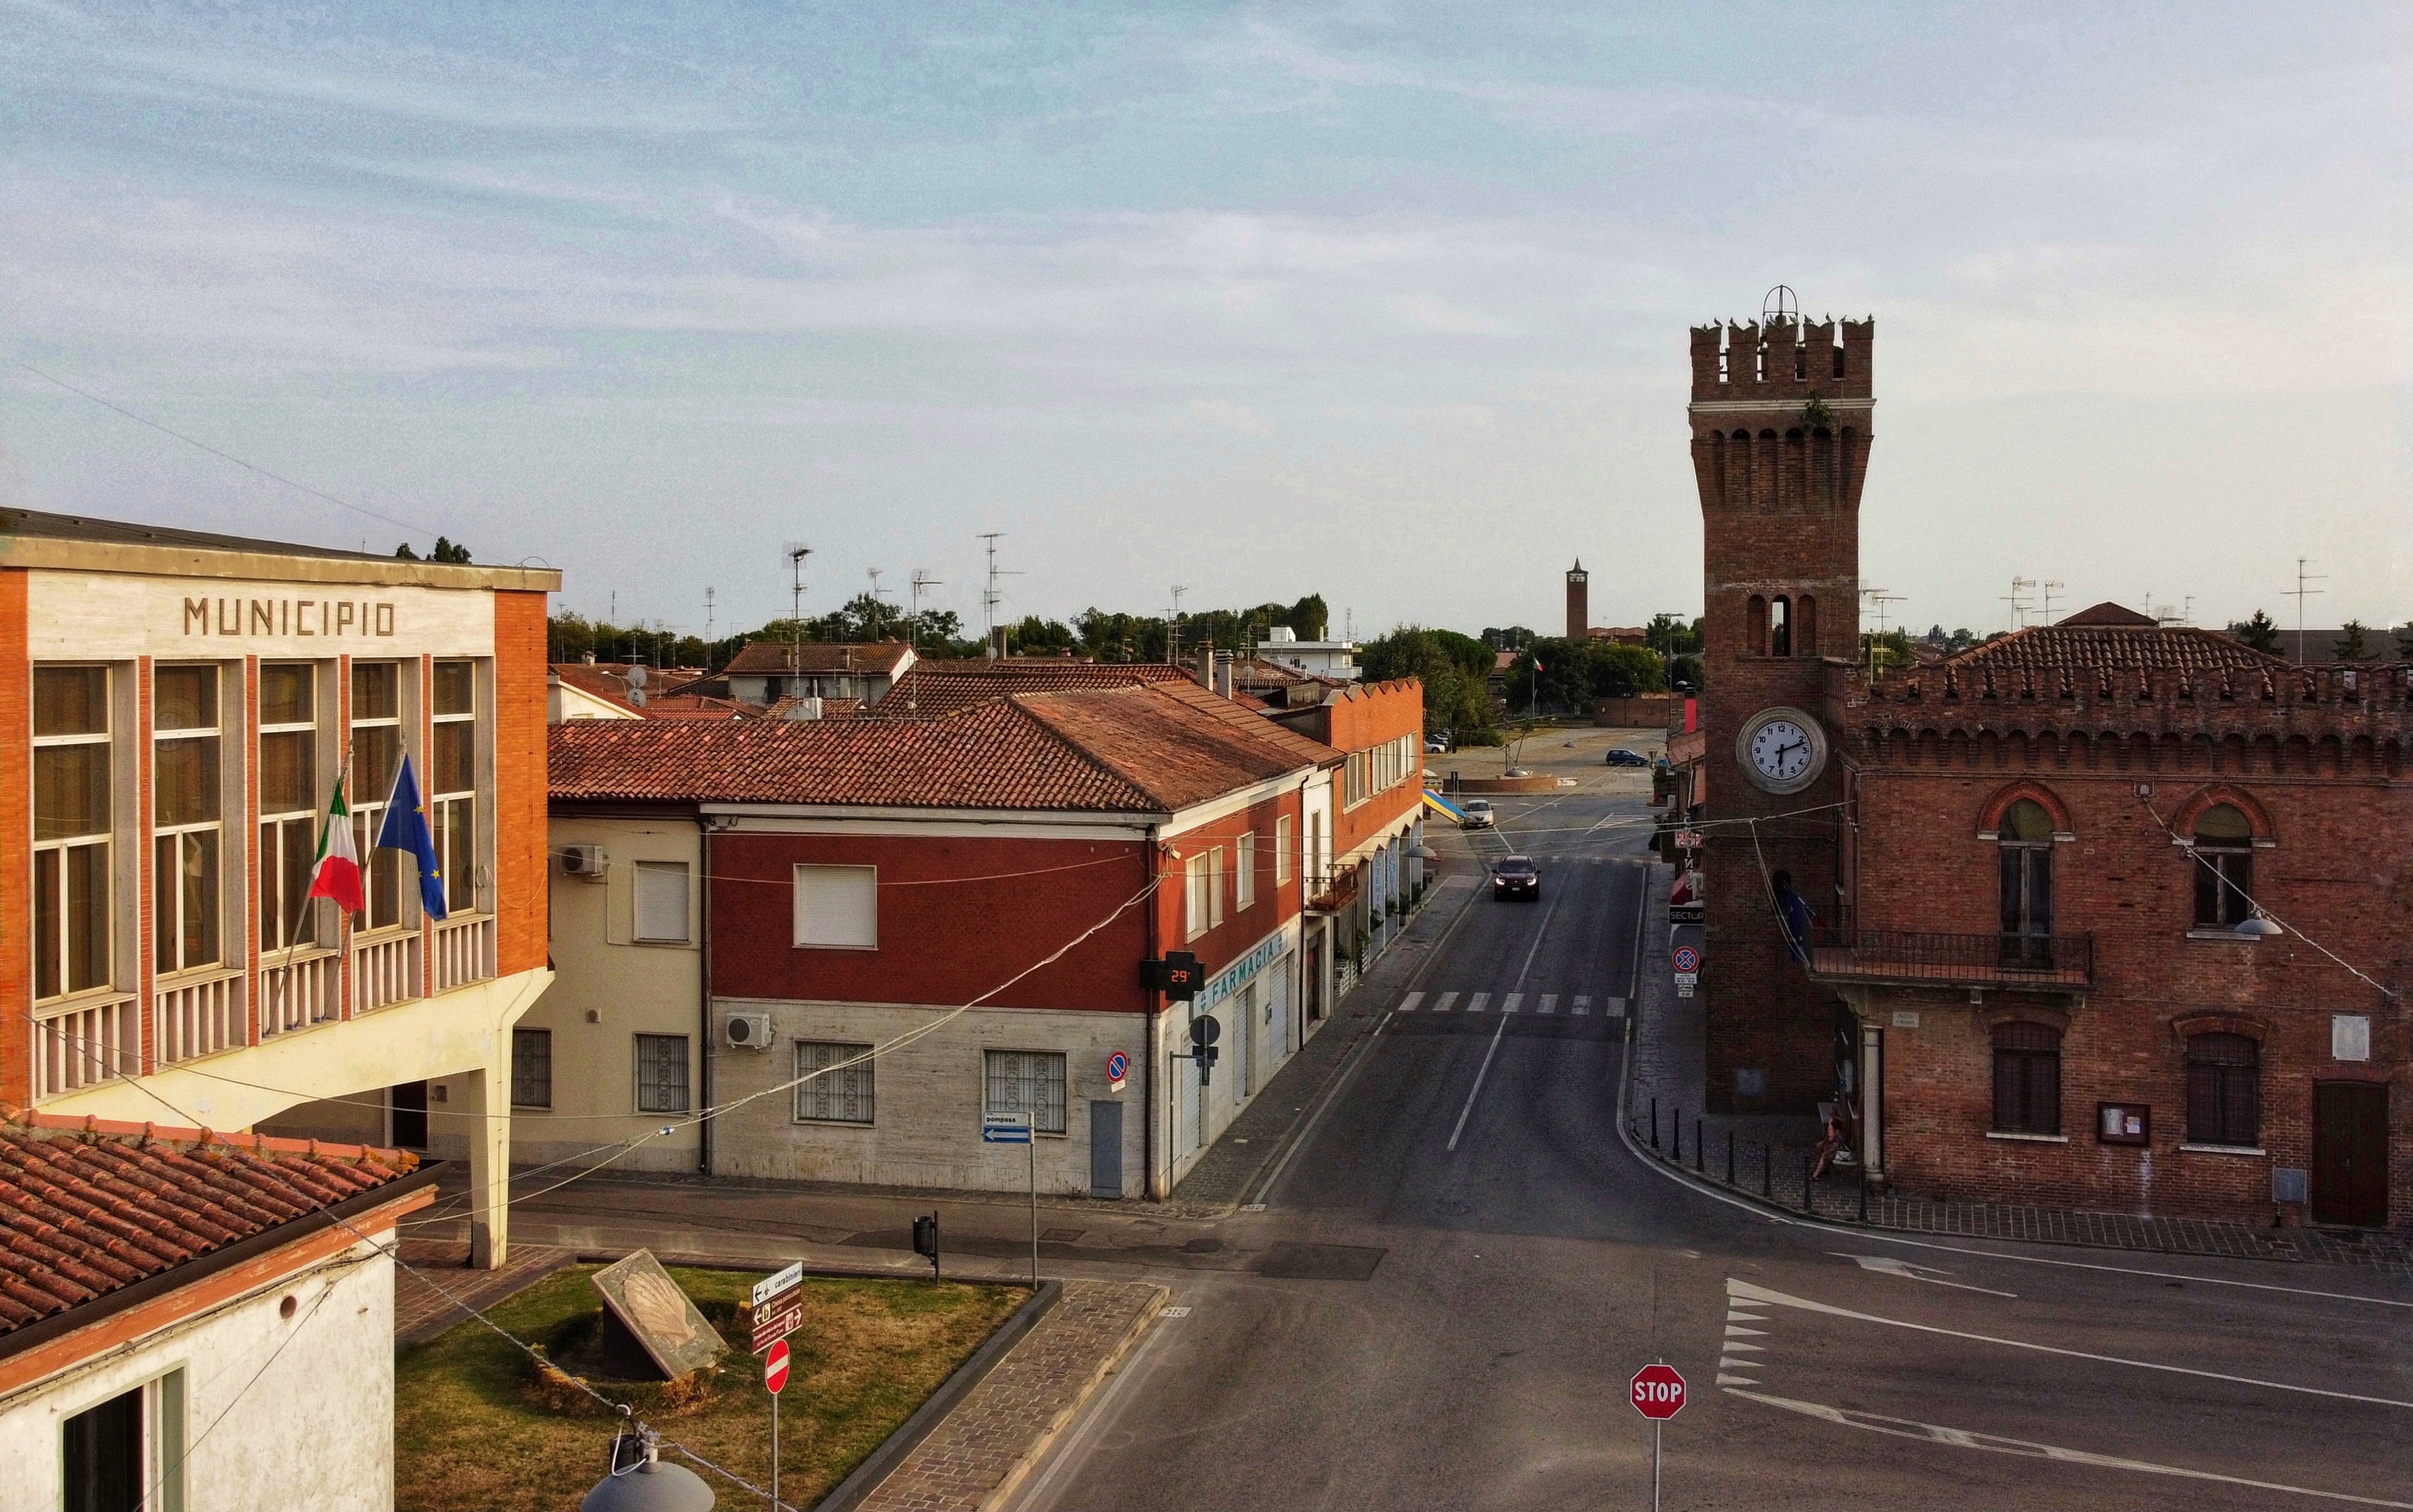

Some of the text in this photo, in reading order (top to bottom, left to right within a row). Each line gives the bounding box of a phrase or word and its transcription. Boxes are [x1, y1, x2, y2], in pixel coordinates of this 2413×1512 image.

[185, 597, 395, 636] MUNICIPIO
[1670, 911, 1704, 920] SECTOR
[1212, 941, 1274, 1004] FARMACIA
[1635, 1381, 1682, 1402] STOP
